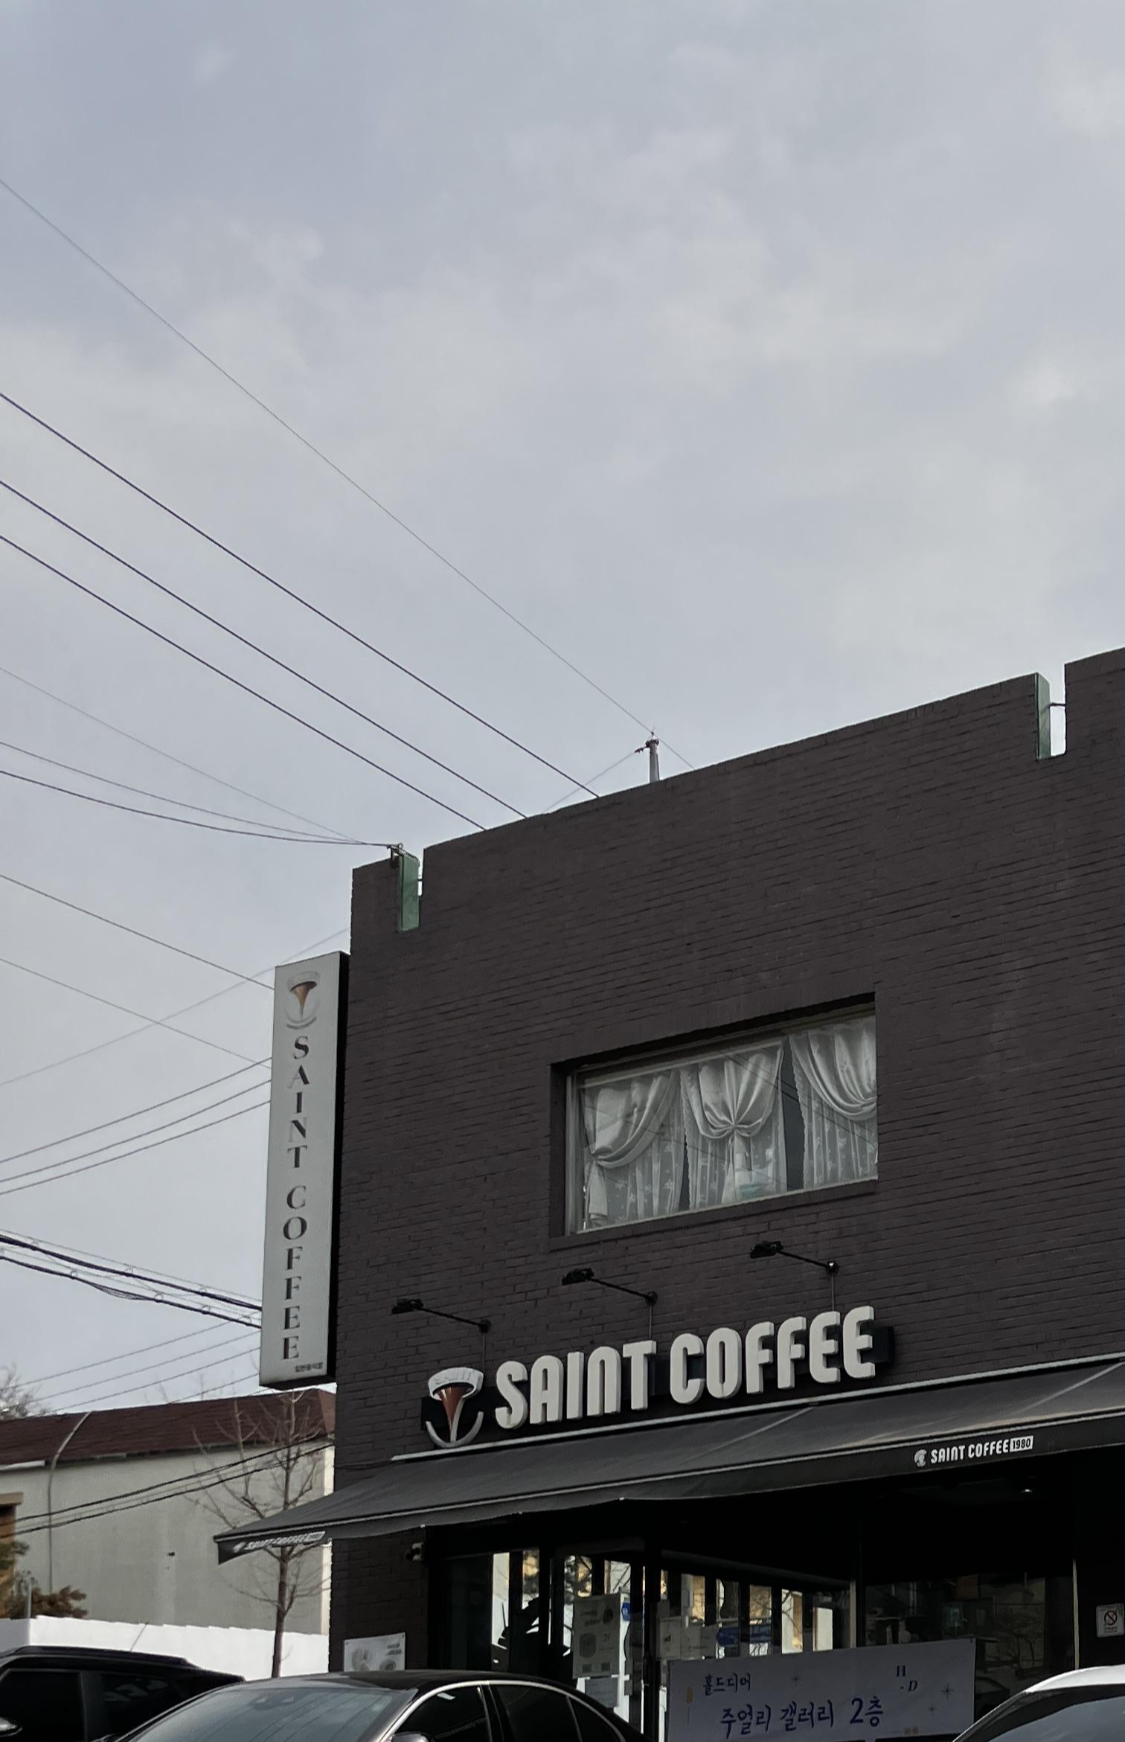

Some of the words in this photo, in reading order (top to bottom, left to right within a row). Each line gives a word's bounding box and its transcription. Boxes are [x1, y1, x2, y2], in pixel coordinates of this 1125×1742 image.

[286, 1035, 310, 1168] SAINT
[282, 1185, 308, 1360] COFFEE
[495, 1339, 656, 1430] SAINT
[669, 1305, 876, 1405] COFFEE
[930, 1445, 965, 1464] SAINT
[967, 1439, 1009, 1459] COFFEE
[1011, 1436, 1032, 1451] 1980
[720, 1703, 772, 1739] 주얼리
[780, 1700, 835, 1733] 갤러리
[849, 1696, 884, 1728] 2층
